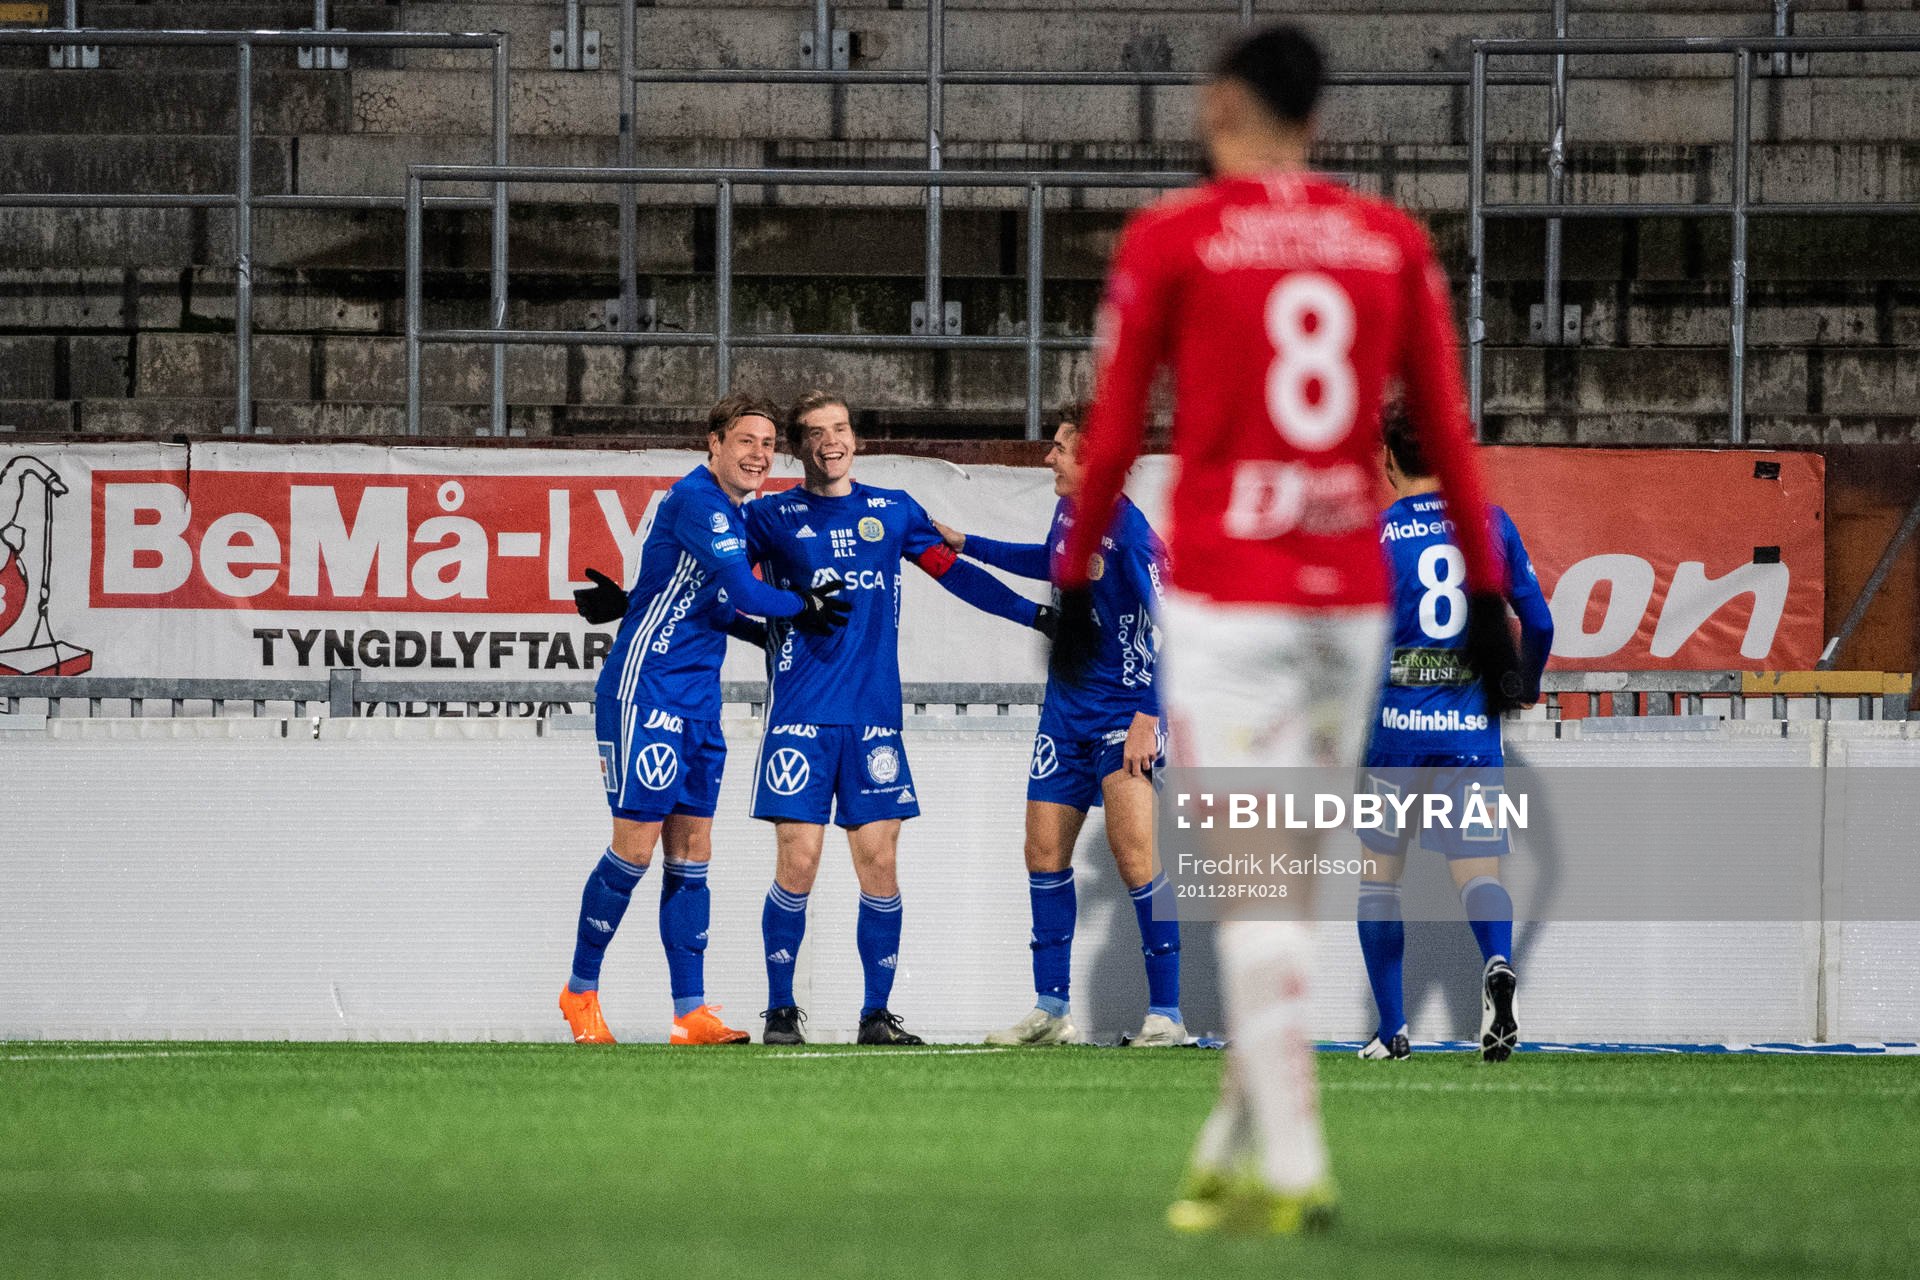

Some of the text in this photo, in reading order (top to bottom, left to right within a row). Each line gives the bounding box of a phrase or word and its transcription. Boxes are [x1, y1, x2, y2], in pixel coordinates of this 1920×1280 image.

[1263, 270, 1358, 452] 8
[834, 548, 857, 559] ALL
[844, 570, 886, 591] SCA
[1417, 543, 1468, 640] 8
[1382, 706, 1489, 731] Molinbil.se
